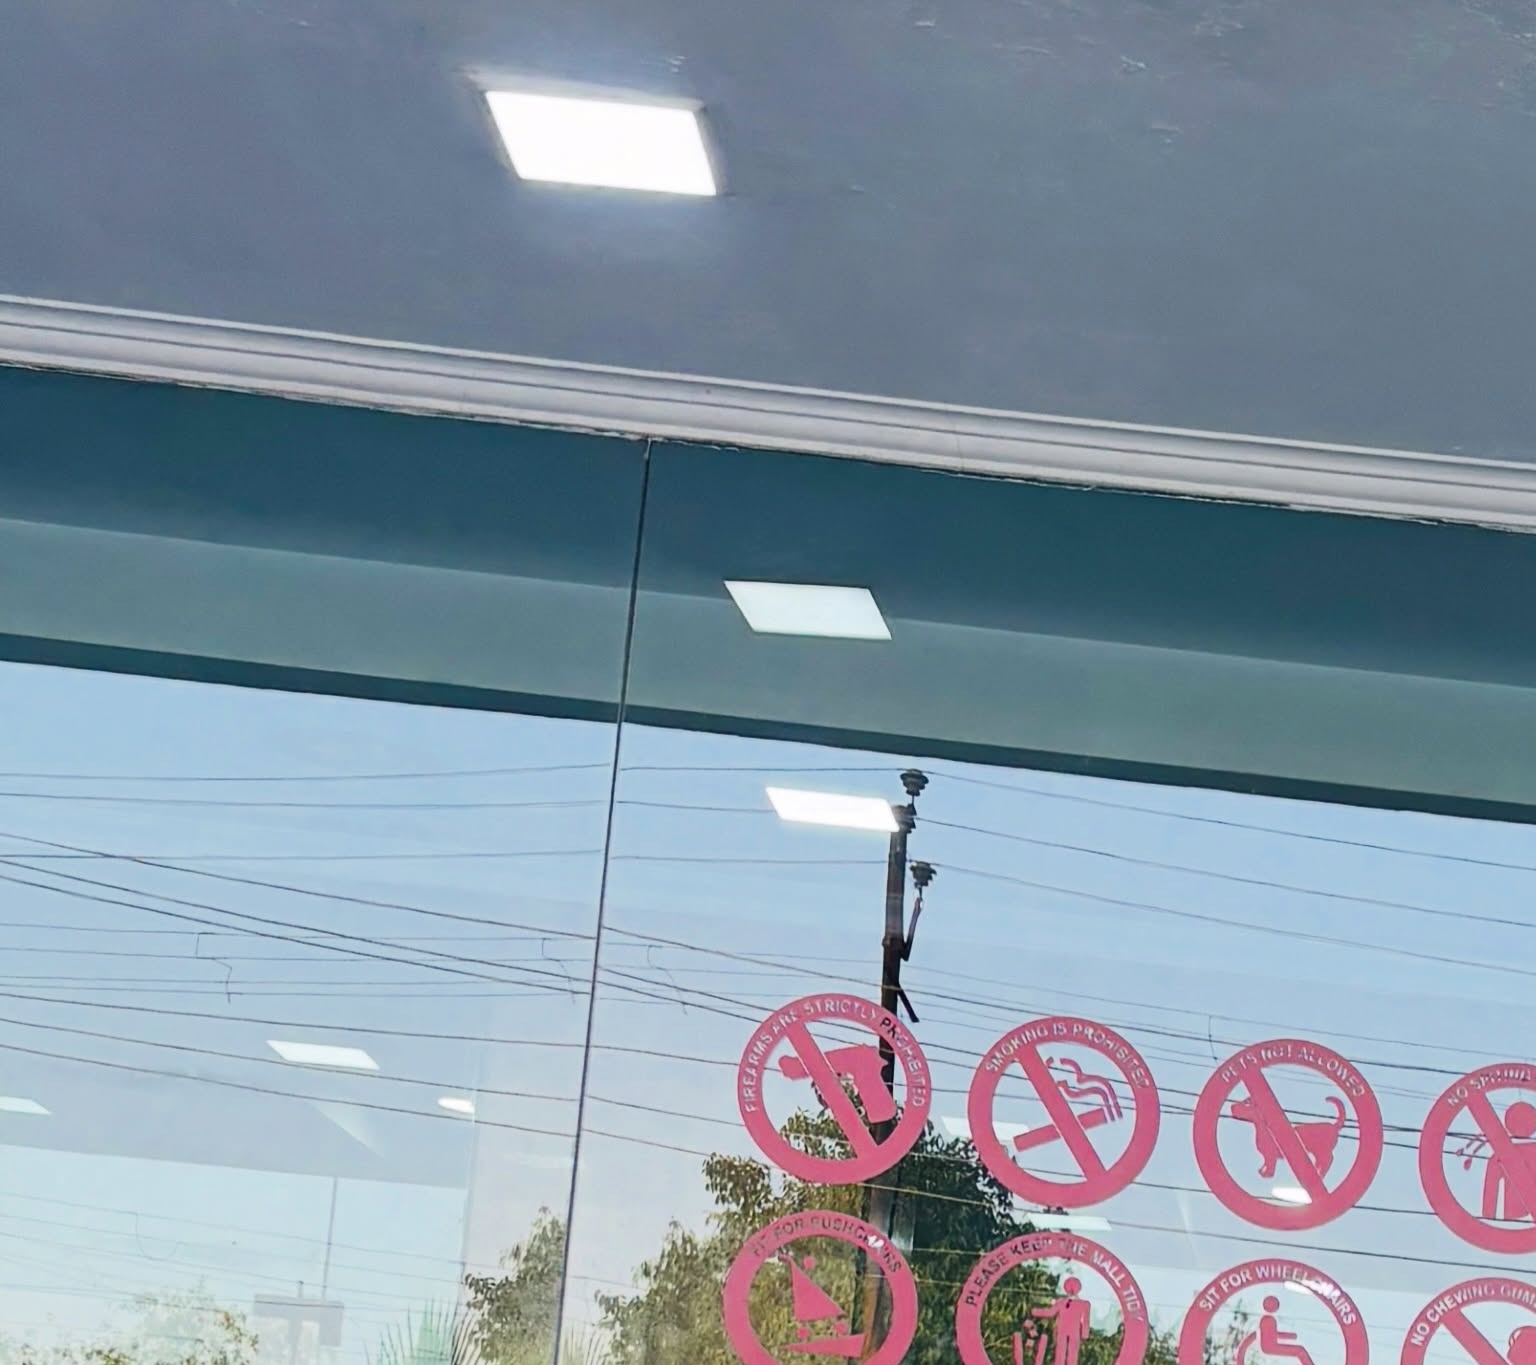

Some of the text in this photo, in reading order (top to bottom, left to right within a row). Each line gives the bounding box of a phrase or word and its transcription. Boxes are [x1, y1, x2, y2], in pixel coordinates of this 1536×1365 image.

[742, 1033, 773, 1112] FIREARMS
[802, 999, 876, 1021] STRICTLY
[985, 1022, 1150, 1089] SMOKING IS PROHIBITED
[965, 1251, 1008, 1307] PLEASE
[1092, 1250, 1126, 1287] MALL
[1220, 1271, 1252, 1293] FOR
[1411, 1322, 1430, 1347] NO
[1426, 1284, 1495, 1323] CHEWING
